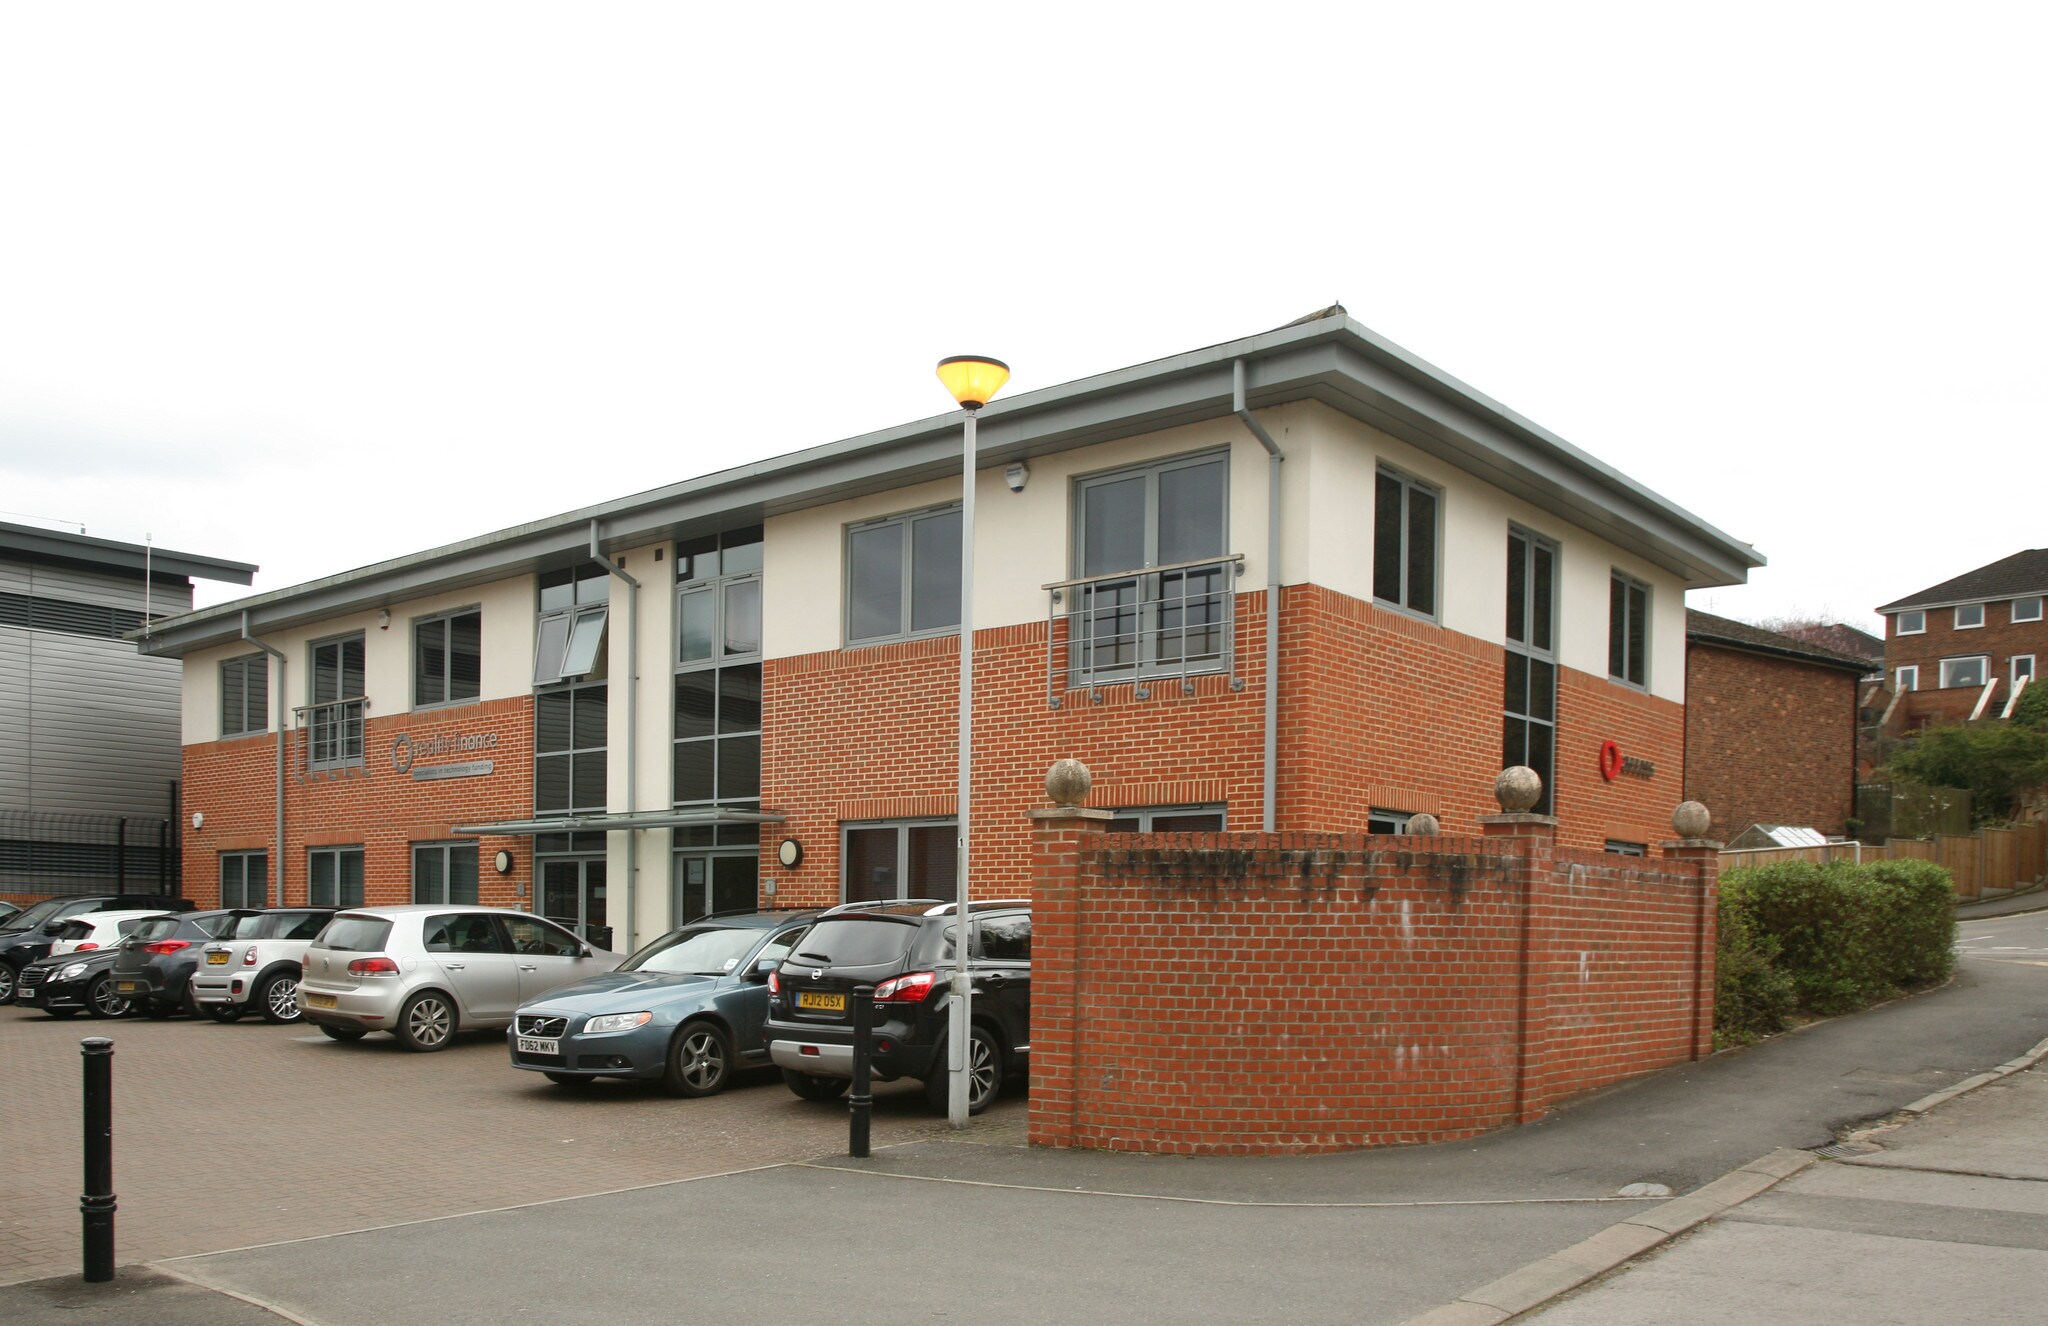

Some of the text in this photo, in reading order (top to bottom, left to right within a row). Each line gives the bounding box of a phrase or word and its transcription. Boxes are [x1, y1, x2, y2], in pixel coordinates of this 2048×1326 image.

[415, 732, 498, 756] reality finance
[471, 762, 492, 772] funding
[803, 994, 822, 1006] RJ12
[520, 1039, 539, 1051] FD62
